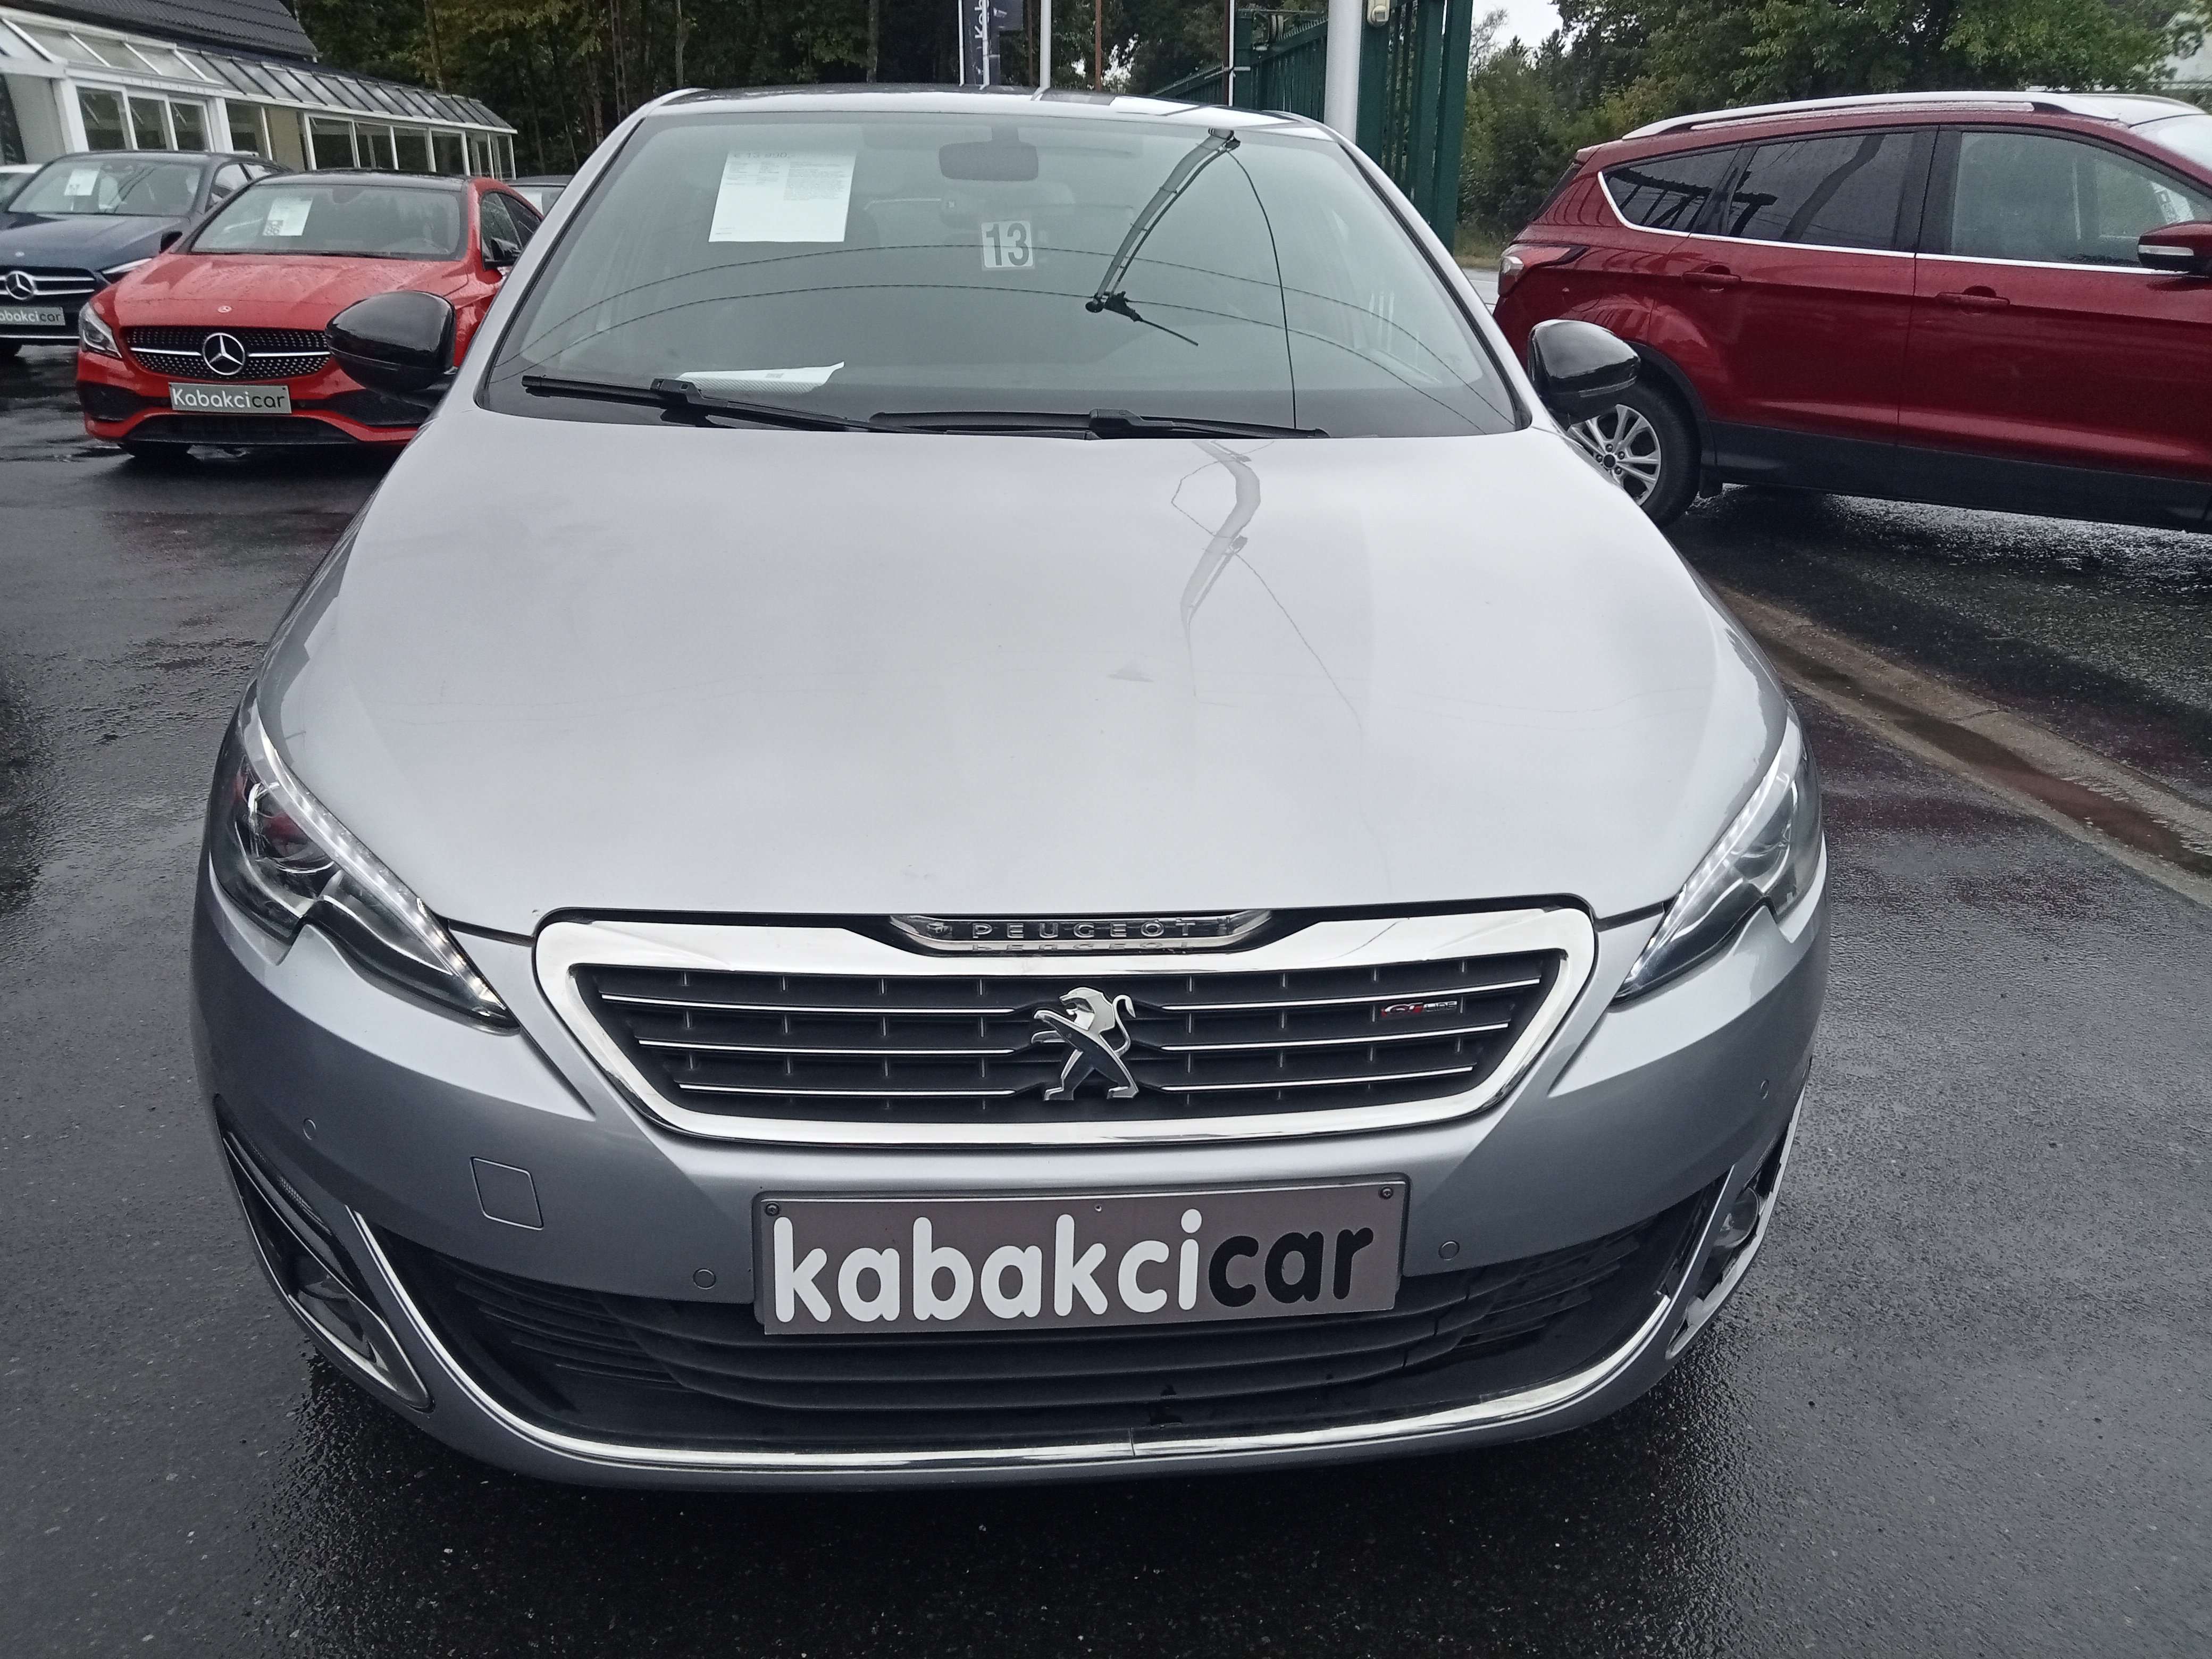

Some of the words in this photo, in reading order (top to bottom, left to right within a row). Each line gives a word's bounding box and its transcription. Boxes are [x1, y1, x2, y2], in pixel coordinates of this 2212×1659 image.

[986, 222, 1029, 266] 13
[172, 388, 285, 408] Kabakcicar
[972, 921, 1196, 939] PEUGEOT
[773, 1208, 1374, 1323] kabakcicar
